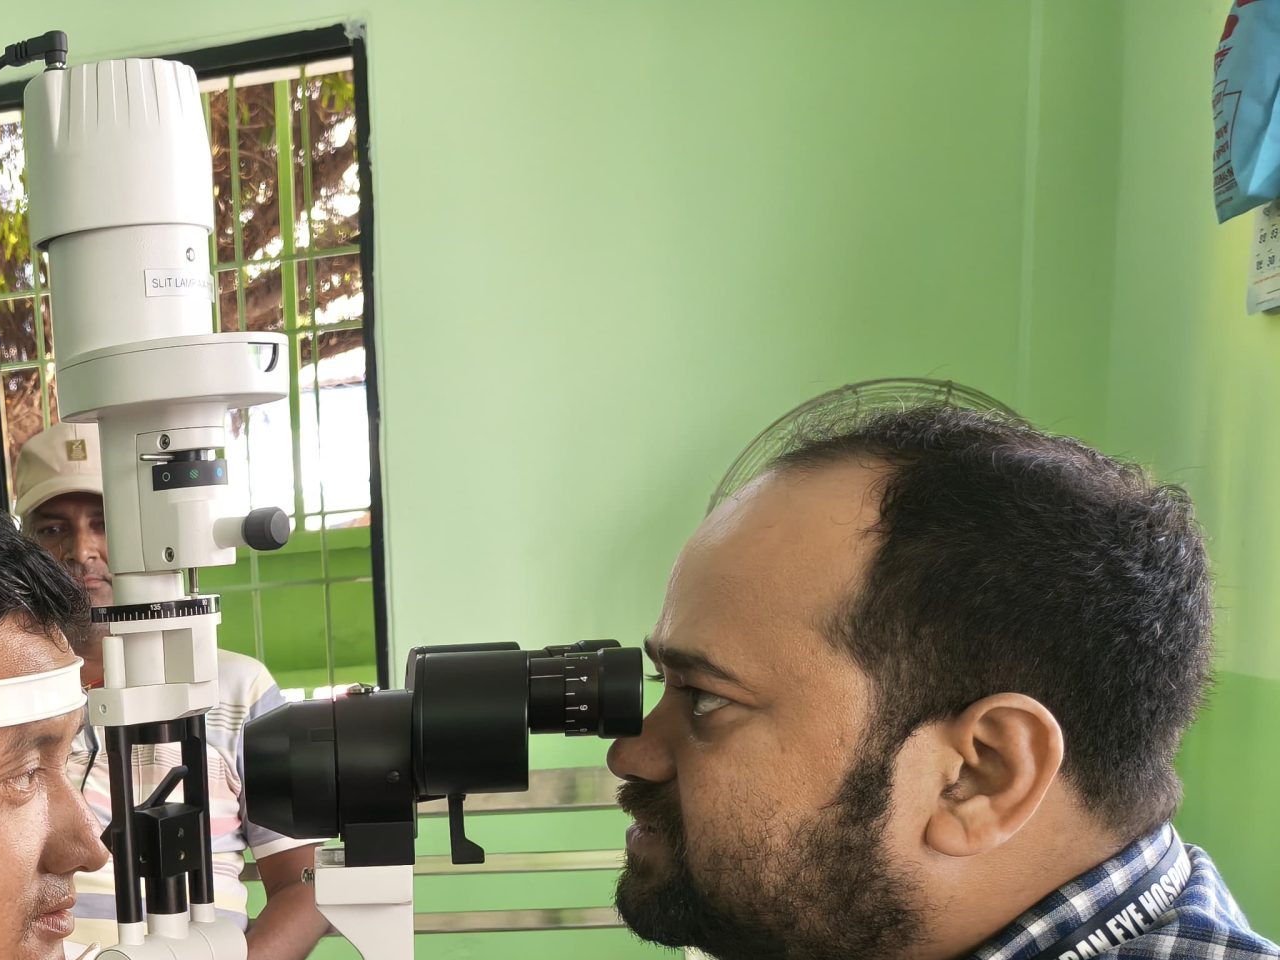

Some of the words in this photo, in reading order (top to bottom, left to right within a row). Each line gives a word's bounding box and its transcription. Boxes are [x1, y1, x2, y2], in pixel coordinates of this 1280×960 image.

[152, 277, 173, 288] SLIT
[150, 603, 161, 611] 135
[1105, 902, 1151, 945] EYE
